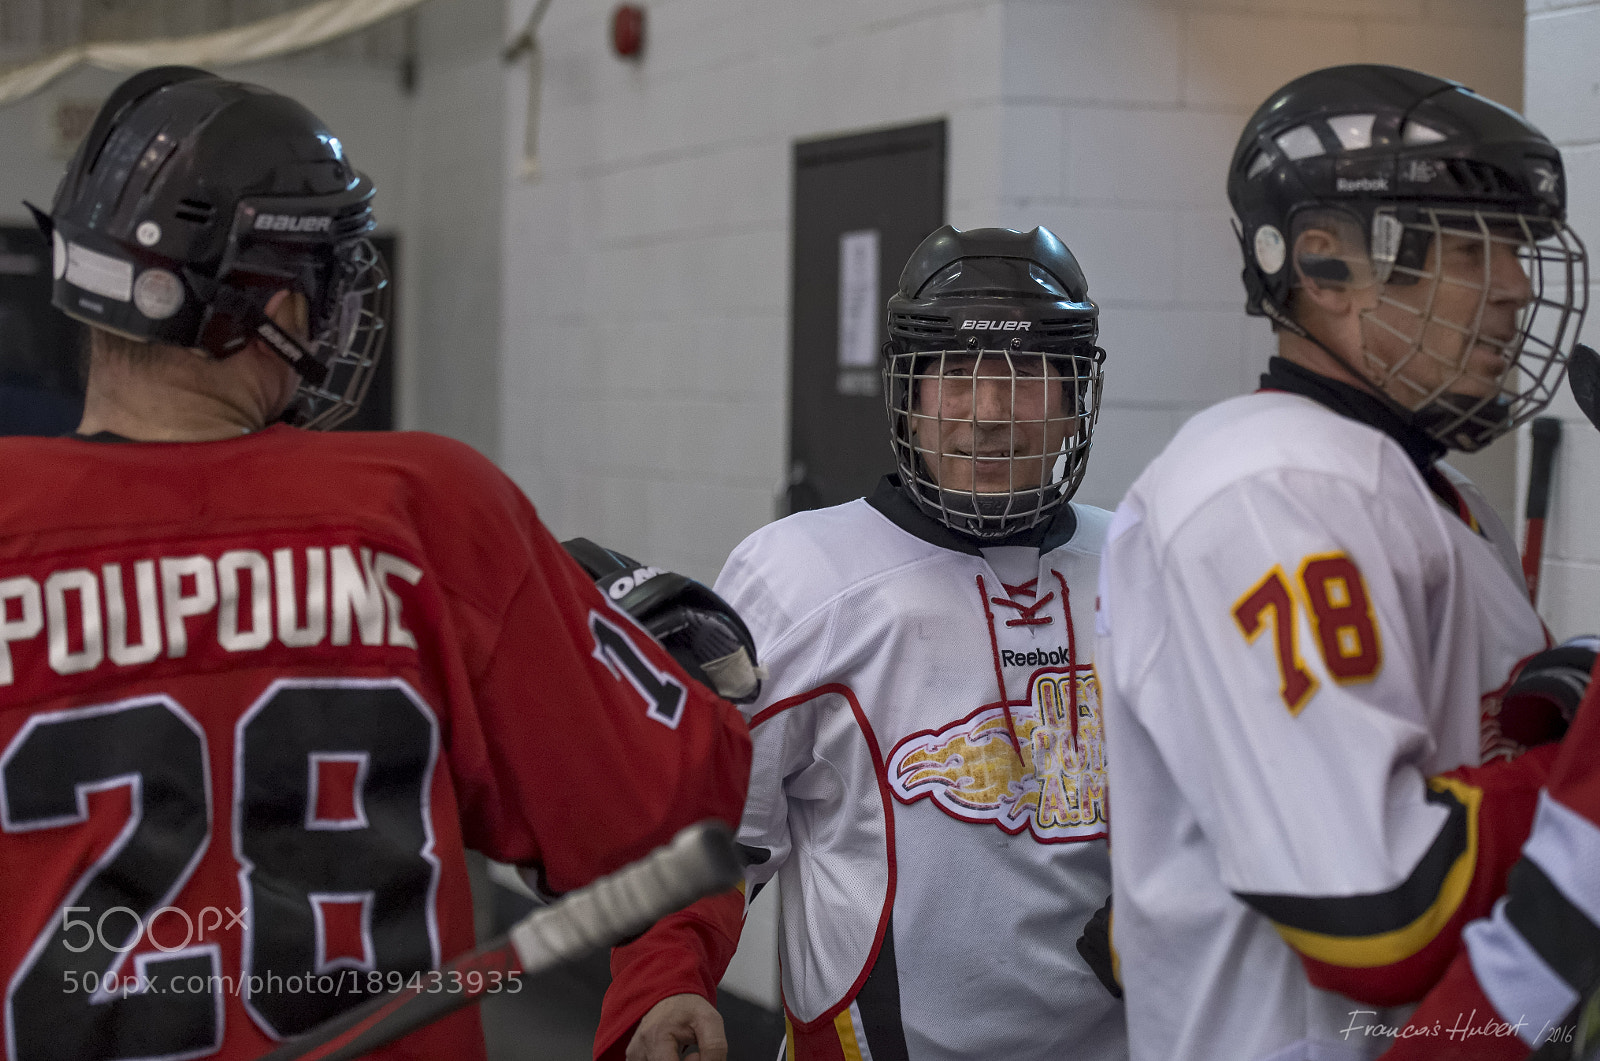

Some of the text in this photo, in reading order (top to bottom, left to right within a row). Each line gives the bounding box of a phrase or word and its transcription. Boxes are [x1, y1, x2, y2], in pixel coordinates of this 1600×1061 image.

[960, 319, 1032, 331] BAUER
[0, 545, 424, 686] POUPOUNE
[1001, 646, 1070, 668] Reebok
[1230, 550, 1385, 718] 78
[0, 678, 441, 1061] 28
